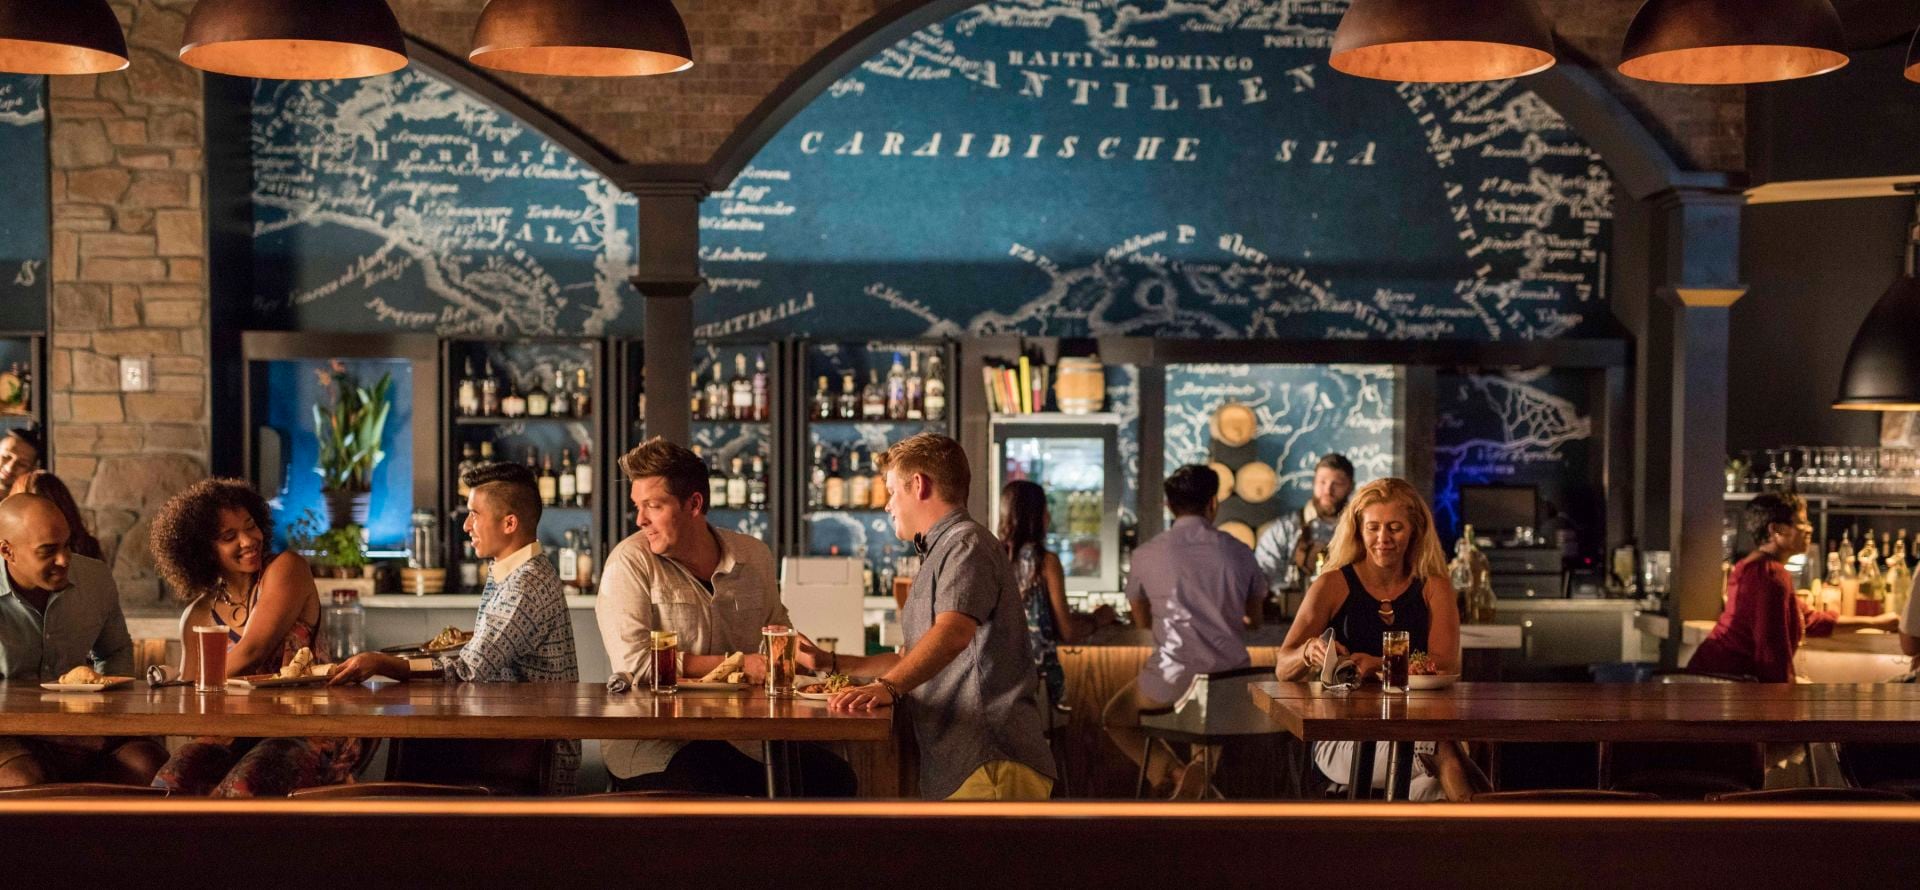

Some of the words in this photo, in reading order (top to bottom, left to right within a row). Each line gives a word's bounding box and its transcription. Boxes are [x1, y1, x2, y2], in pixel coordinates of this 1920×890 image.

[1008, 50, 1093, 67] HAITI
[1145, 54, 1254, 71] DOMINGO
[800, 131, 1200, 162] CARAIBISCHE
[1275, 139, 1378, 165] SEA
